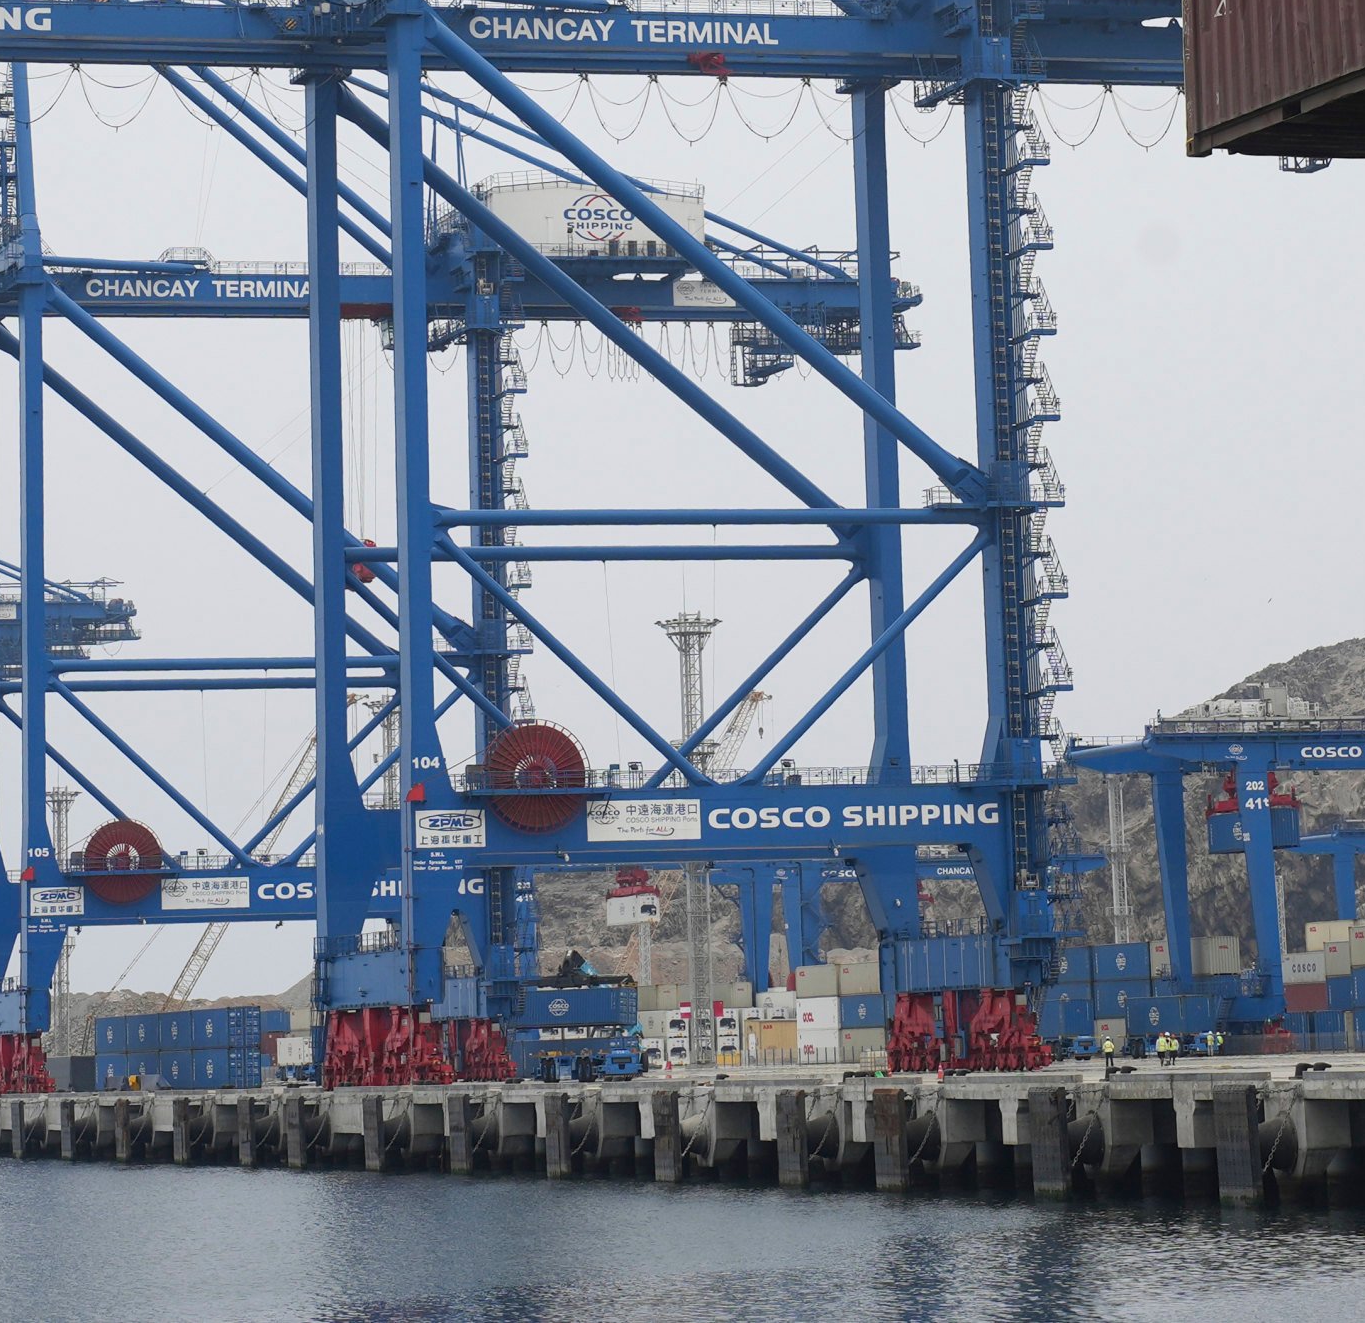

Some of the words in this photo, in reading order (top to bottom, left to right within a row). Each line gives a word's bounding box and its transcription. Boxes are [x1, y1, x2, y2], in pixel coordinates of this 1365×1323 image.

[469, 16, 614, 41] CHANCAY
[631, 20, 779, 45] TERMINAL
[564, 208, 635, 221] COSCO
[567, 222, 632, 230] SHIPPING
[86, 279, 199, 298] CHANCAY
[212, 280, 309, 298] TERMINA
[1301, 746, 1362, 758] COSCO
[412, 757, 439, 769] 104
[1246, 781, 1264, 790] 202
[1245, 797, 1269, 809] 41t
[626, 804, 697, 816] 中遠海運港口
[708, 806, 831, 829] COSCO
[842, 803, 999, 827] SHIPPING
[429, 818, 473, 827] ZPMC
[420, 834, 482, 845] 上海振华重工
[28, 848, 49, 857] 105
[40, 892, 76, 900] ZPMC
[257, 882, 316, 899] COS
[1292, 964, 1316, 973] COSCO
